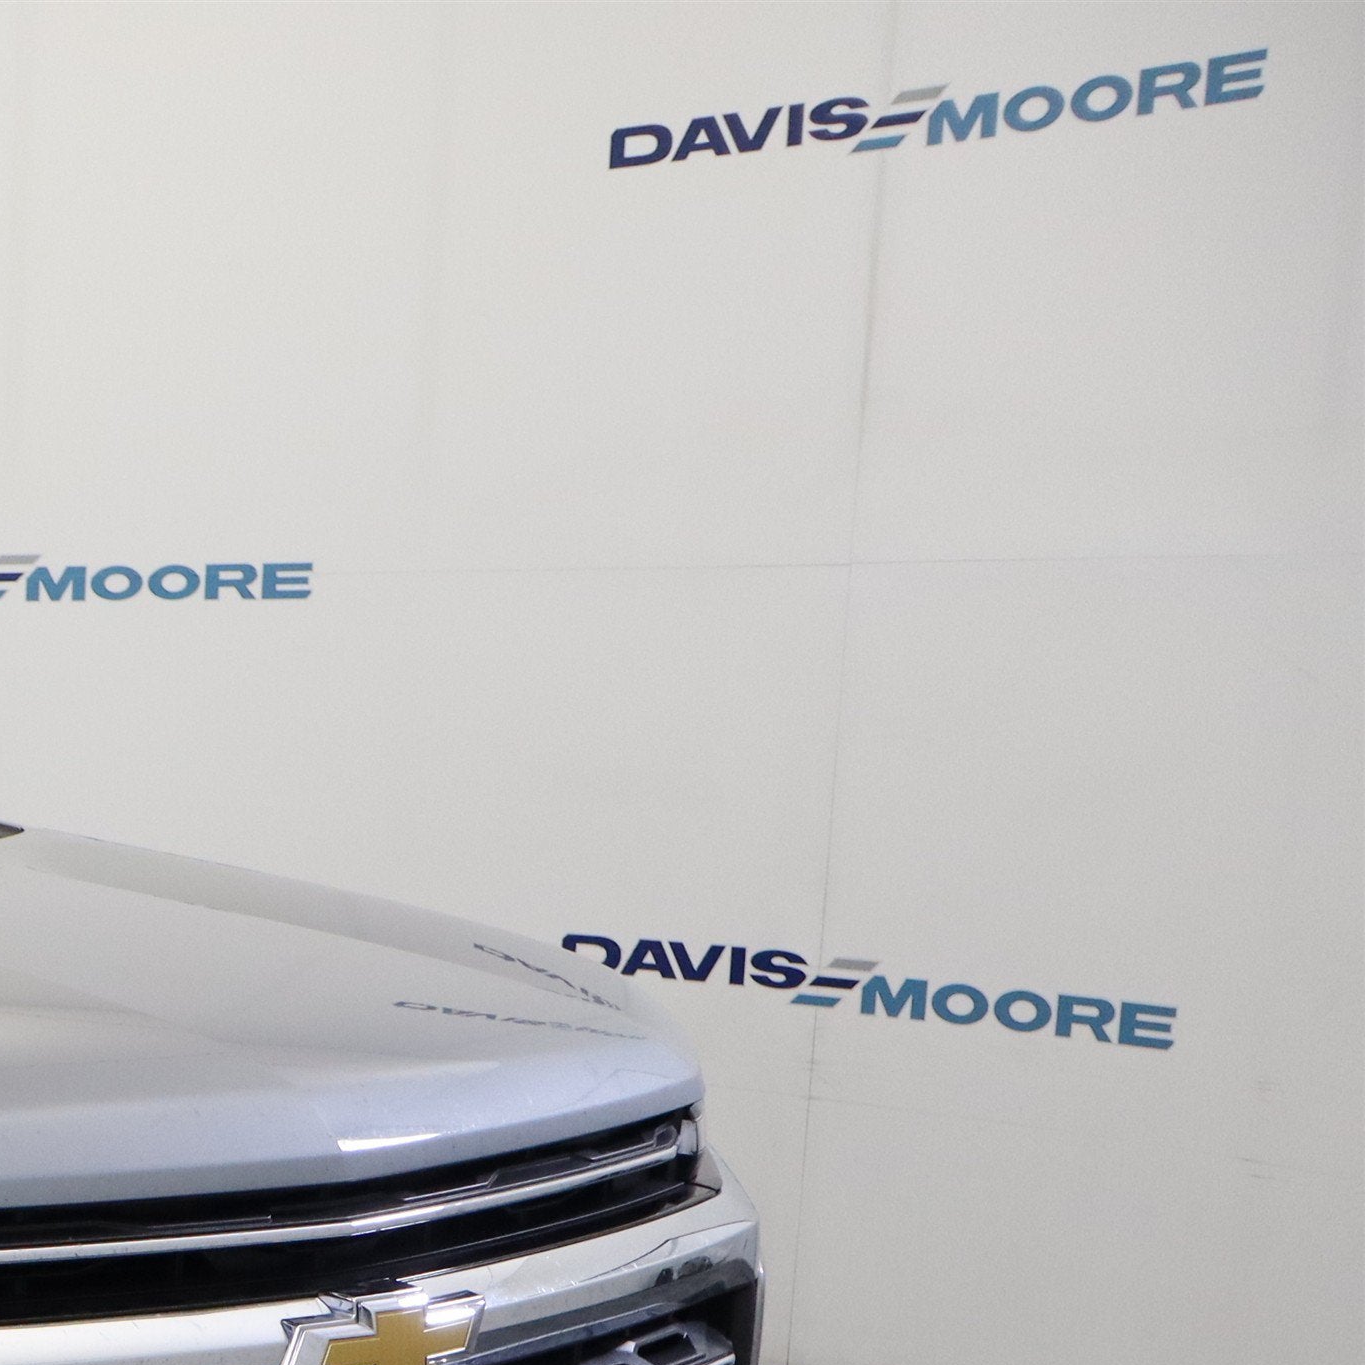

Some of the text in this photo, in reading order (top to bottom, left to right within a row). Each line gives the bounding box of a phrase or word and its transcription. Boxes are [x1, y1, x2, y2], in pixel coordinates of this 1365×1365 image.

[608, 48, 1269, 169] DAVIS MOORE
[25, 563, 313, 601] MOORE
[562, 933, 808, 989] DAVIS
[859, 975, 1177, 1050] MOORE
